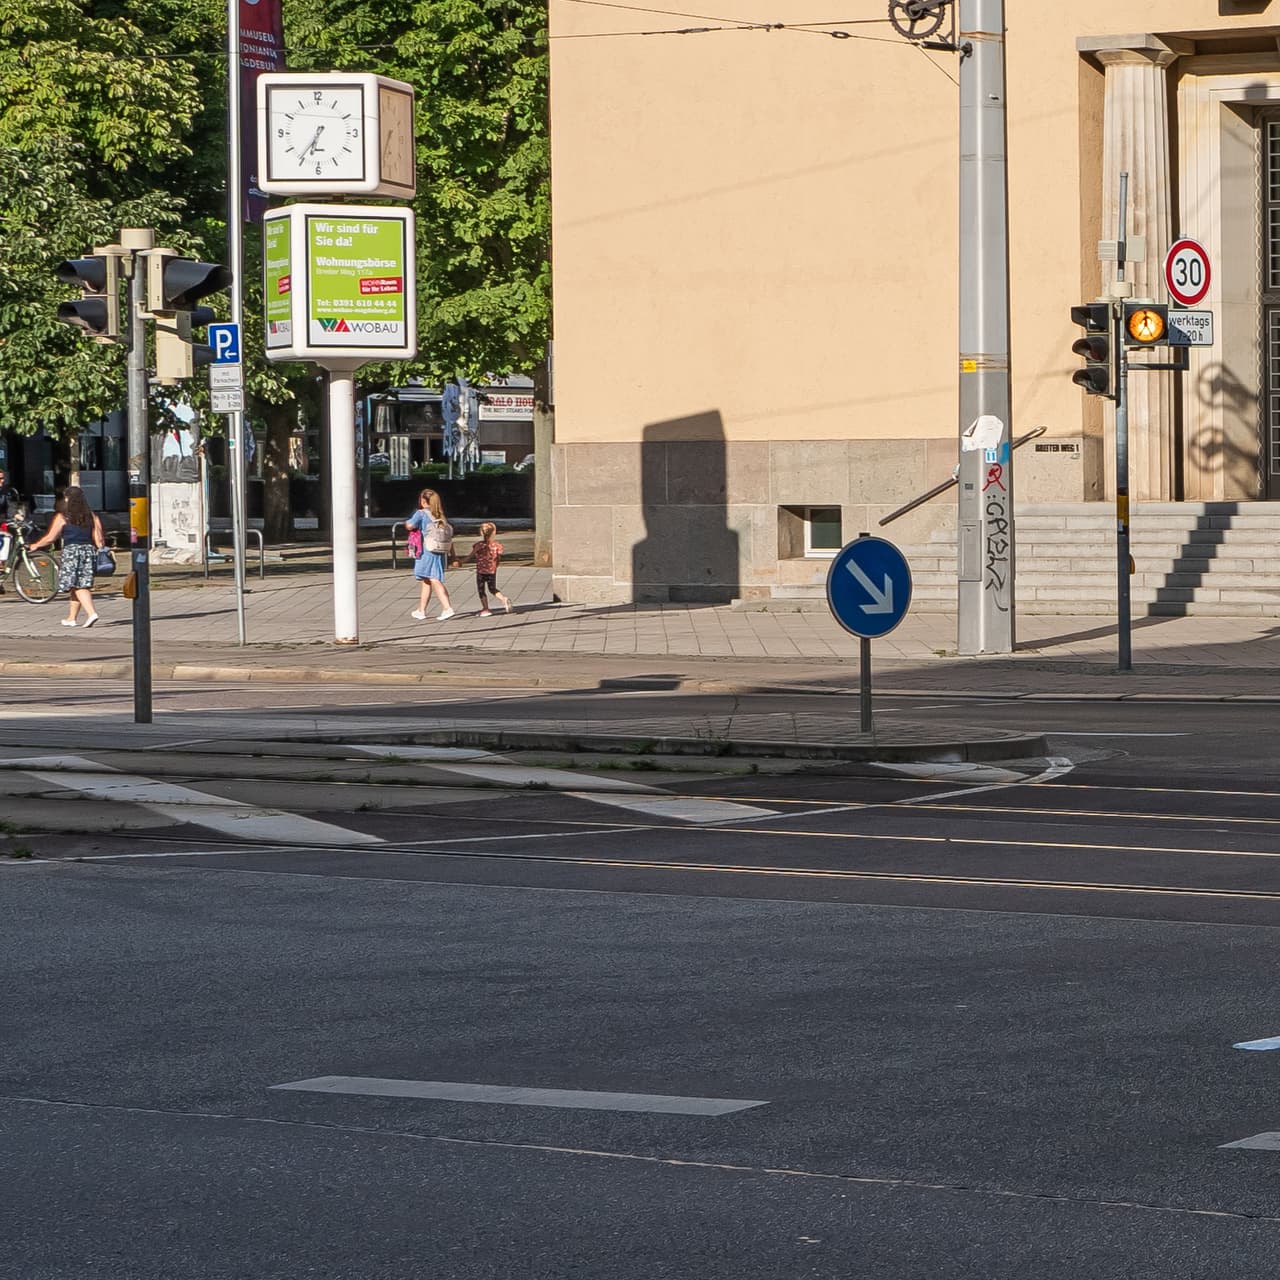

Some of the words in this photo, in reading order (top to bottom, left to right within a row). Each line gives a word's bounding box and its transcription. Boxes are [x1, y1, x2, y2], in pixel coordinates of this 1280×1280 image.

[314, 92, 322, 101] 12
[278, 129, 284, 138] 9
[353, 129, 358, 138] 3
[316, 166, 321, 175] 6
[315, 223, 334, 232] Wir
[337, 223, 360, 233] sind
[363, 224, 378, 234] für
[315, 236, 333, 246] Sie
[336, 236, 353, 246] da!
[316, 257, 396, 269] Wohnungsbörse
[1175, 258, 1201, 286] 30
[351, 322, 398, 333] WOBAU
[1169, 315, 1210, 329] werktags
[215, 329, 232, 359] P
